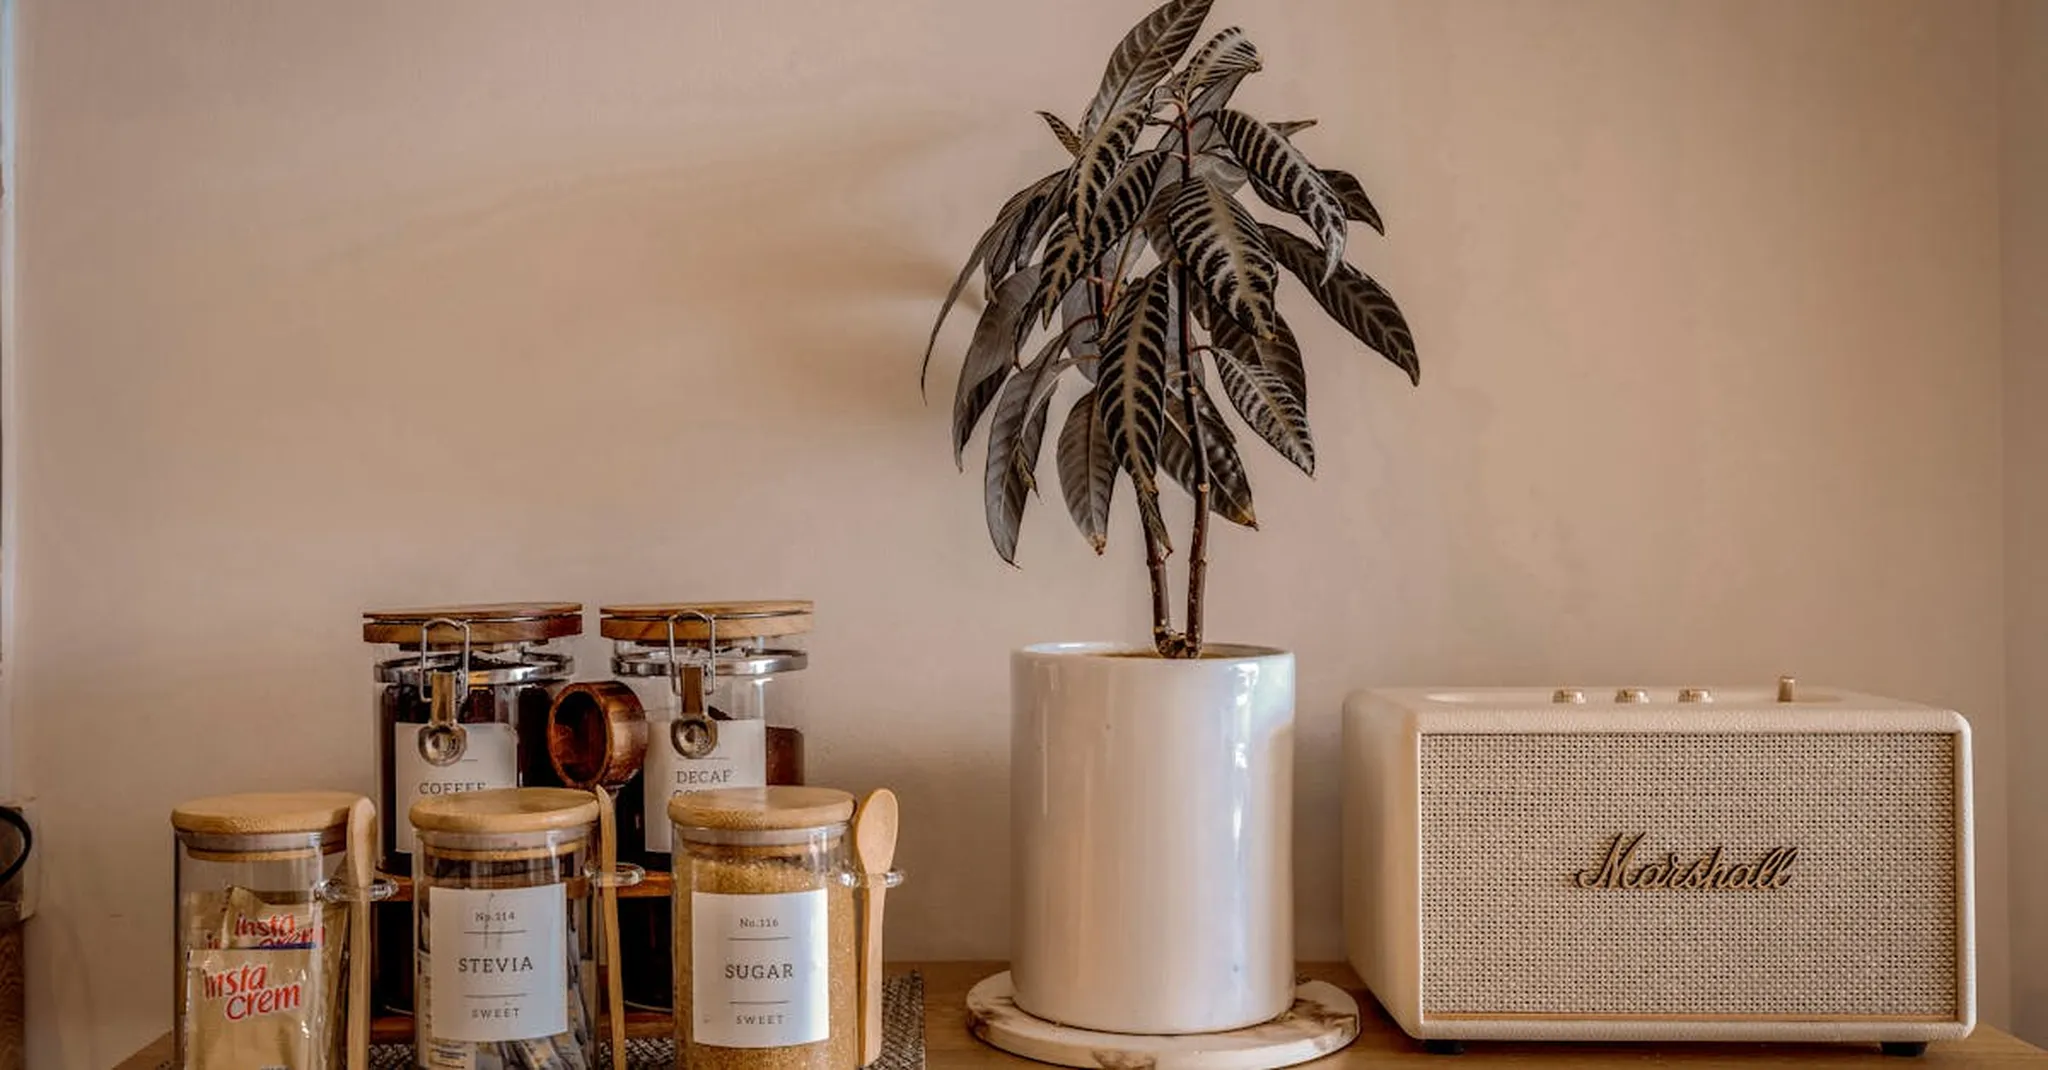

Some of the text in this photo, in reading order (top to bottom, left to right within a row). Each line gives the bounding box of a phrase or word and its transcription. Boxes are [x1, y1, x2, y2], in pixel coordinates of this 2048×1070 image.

[676, 769, 733, 784] DECAF
[1576, 832, 1799, 889] Marshall
[458, 956, 534, 974] STEVIA
[724, 963, 794, 980] SUGAR
[471, 1007, 520, 1020] SWEET
[735, 1014, 785, 1026] SWEET
